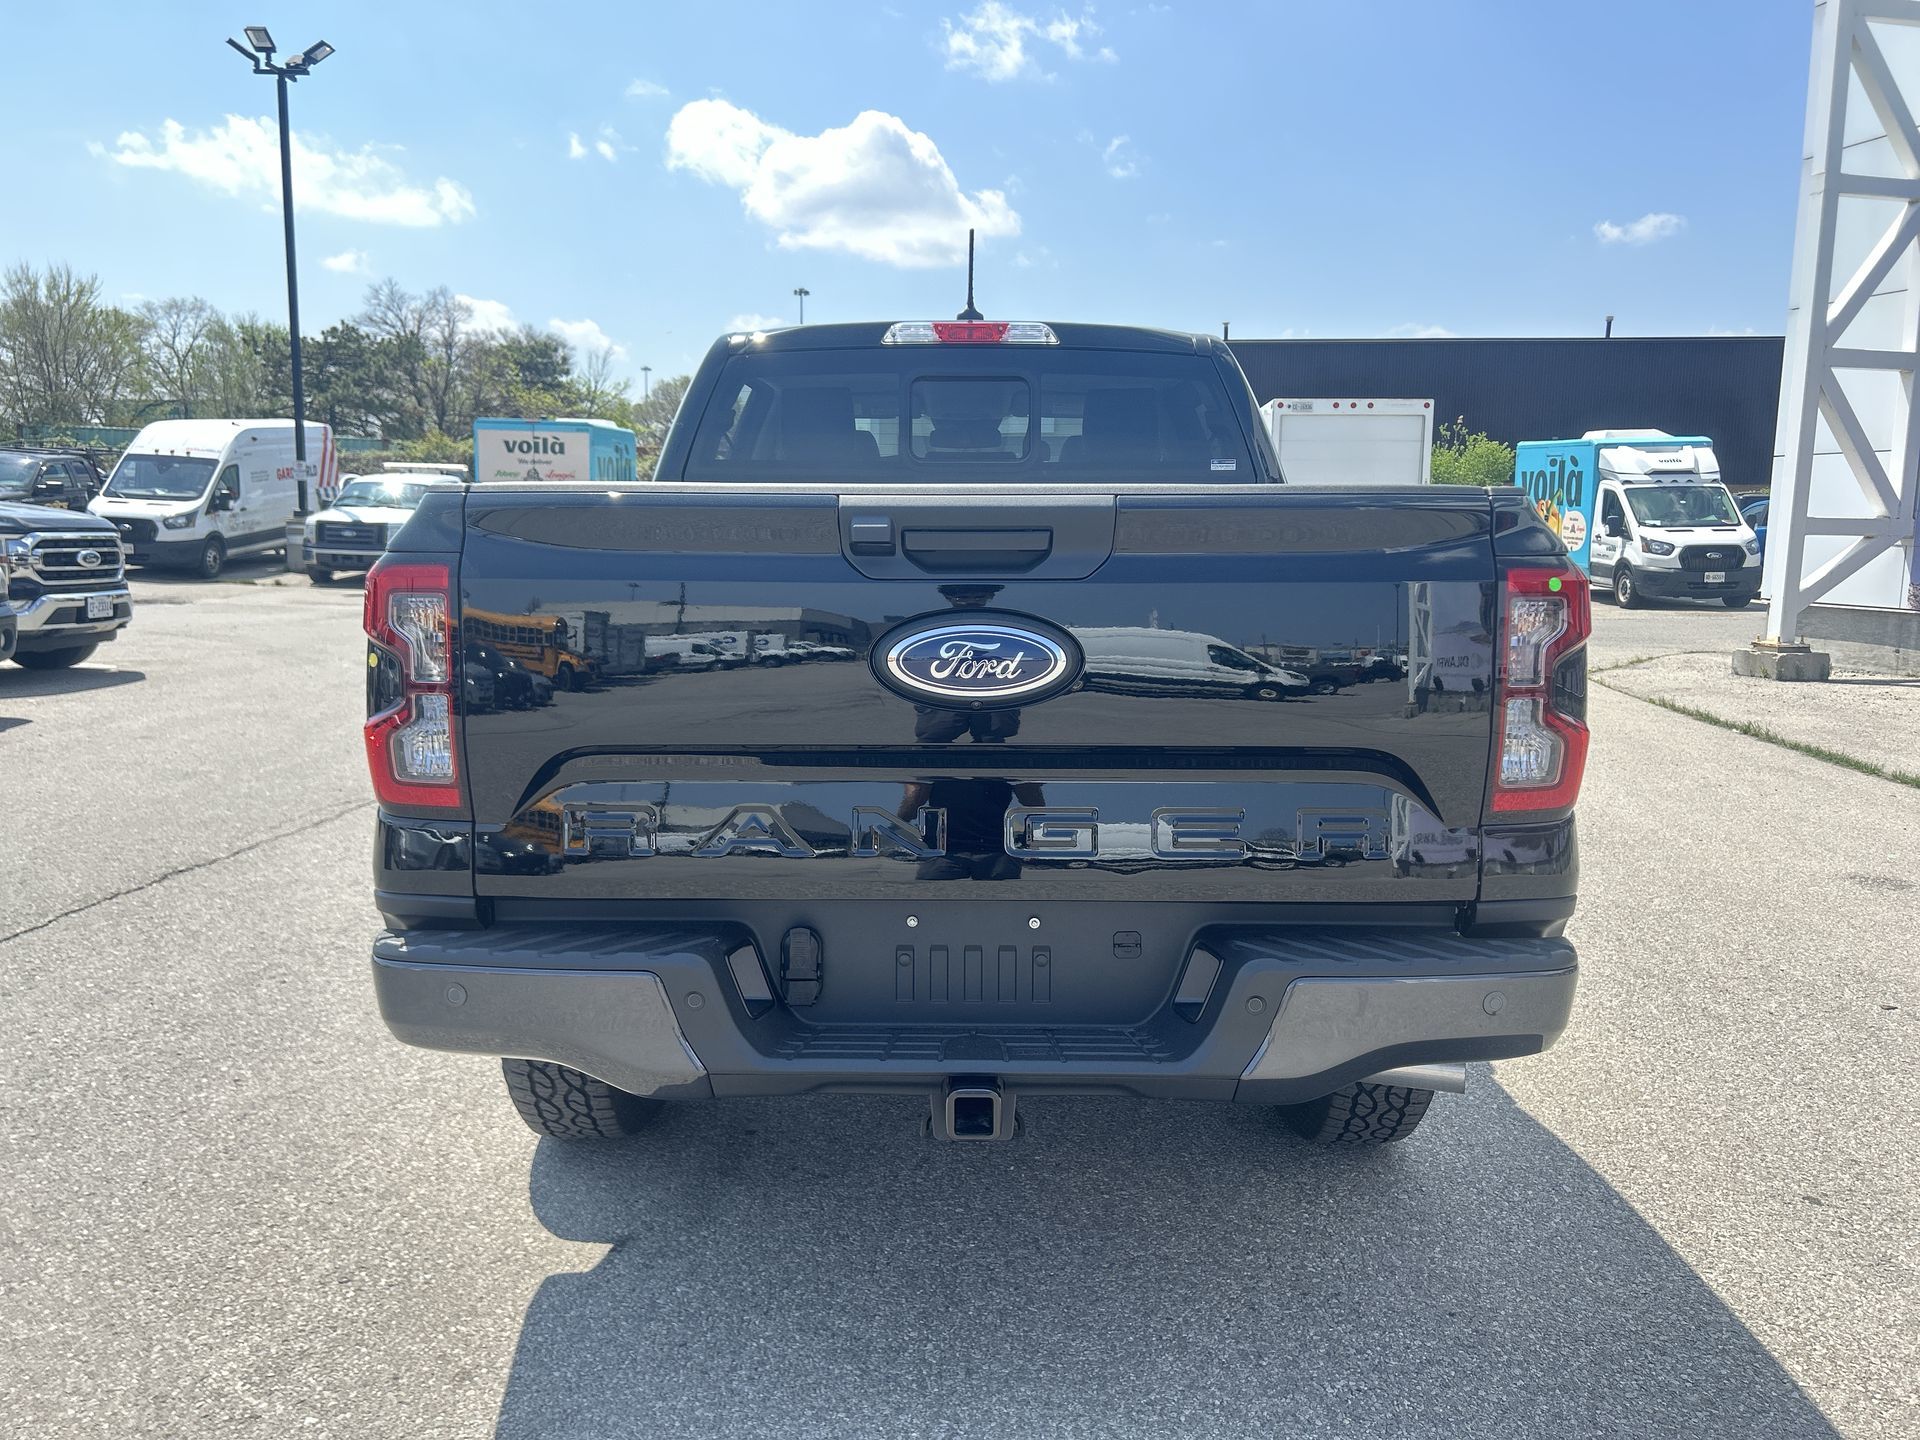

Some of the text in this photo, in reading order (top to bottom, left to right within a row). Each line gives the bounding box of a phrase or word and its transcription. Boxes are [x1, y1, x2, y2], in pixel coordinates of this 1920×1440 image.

[504, 436, 566, 455] voilà
[1521, 455, 1584, 508] voilà
[930, 640, 1025, 679] Ford
[563, 804, 1391, 859] RANGER
